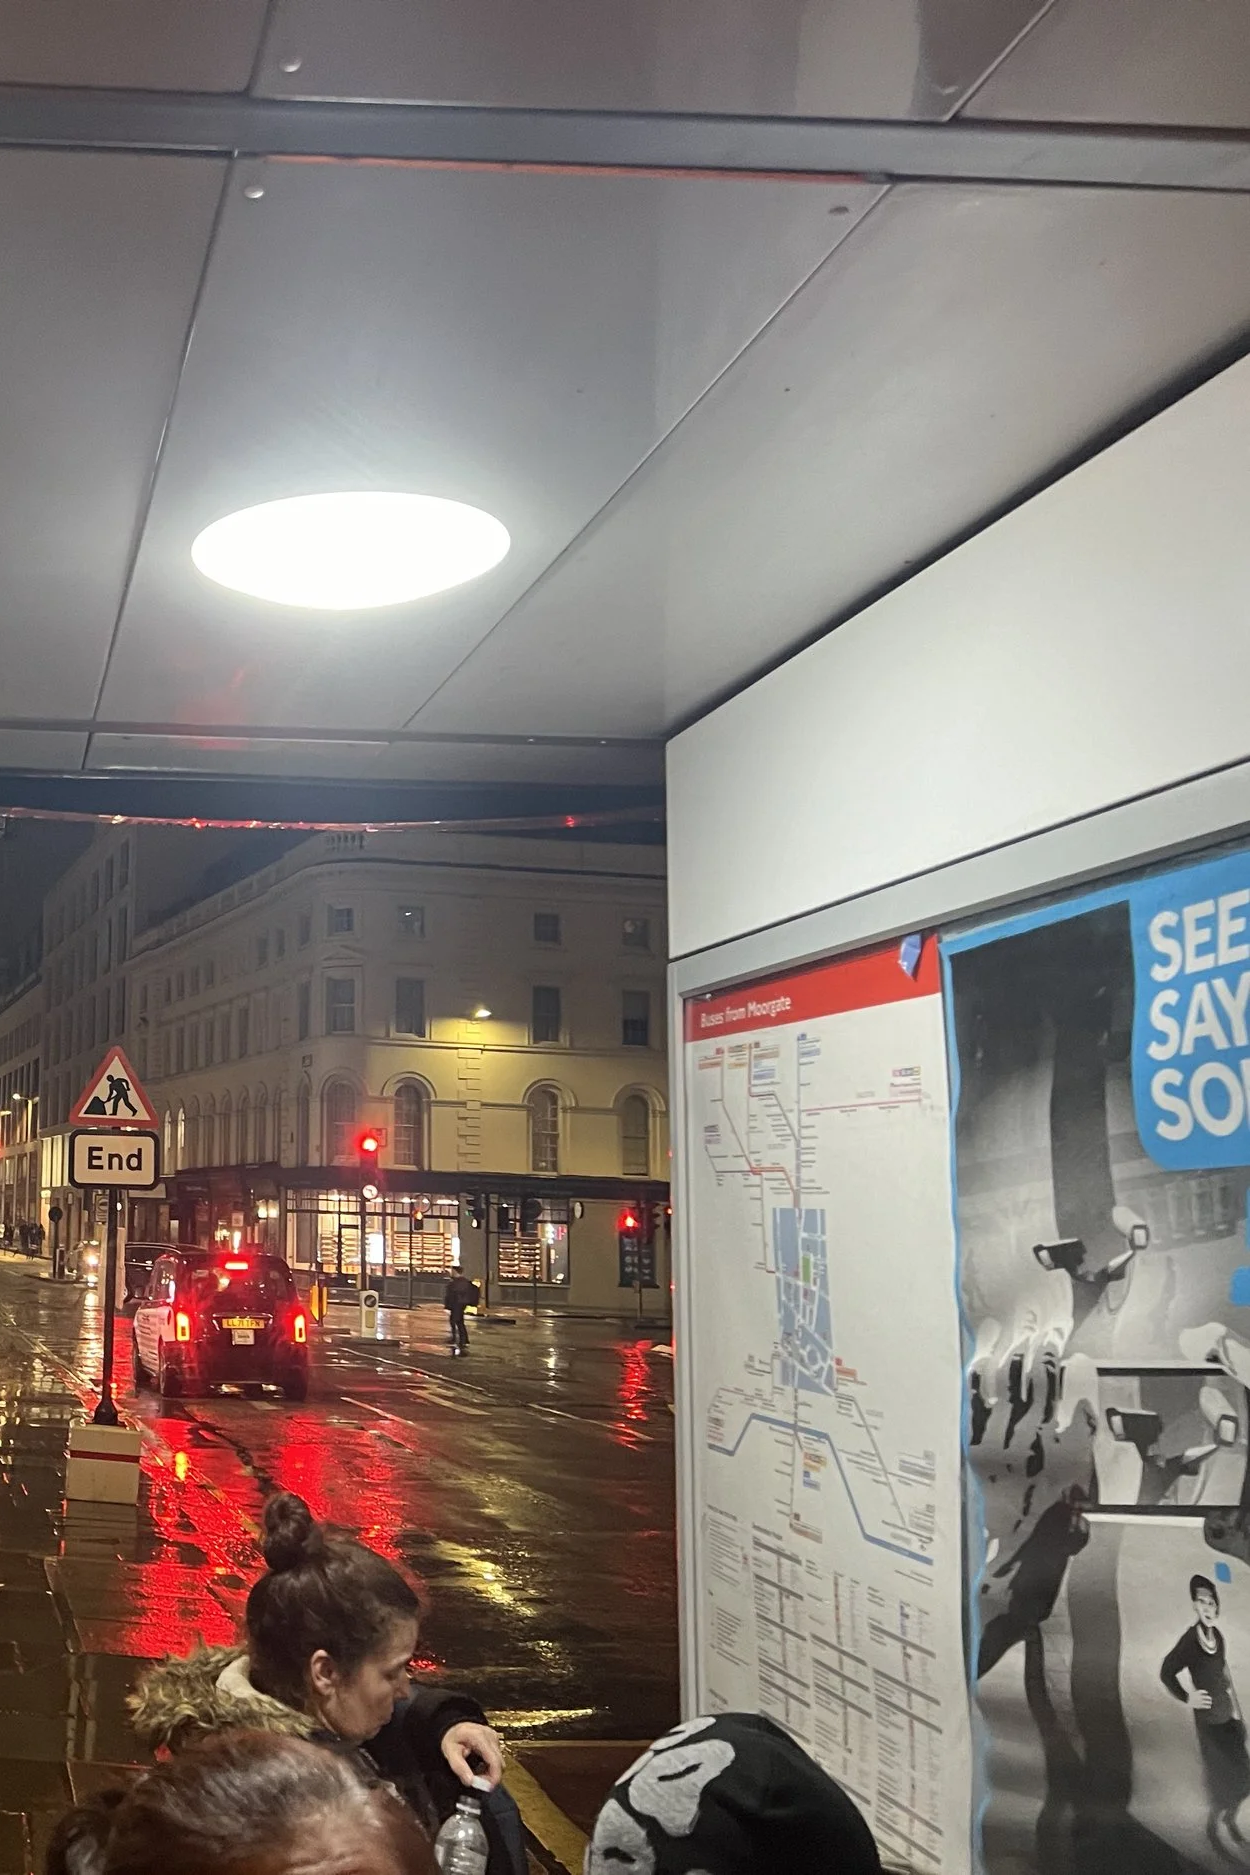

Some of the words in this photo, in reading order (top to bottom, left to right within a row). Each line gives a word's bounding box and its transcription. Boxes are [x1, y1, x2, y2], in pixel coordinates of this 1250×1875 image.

[1148, 888, 1250, 983] SEE
[701, 1012, 724, 1028] Buses
[725, 1006, 745, 1022] from
[747, 996, 791, 1018] Moorgate
[1146, 971, 1250, 1061] SAY
[1151, 1058, 1250, 1142] SO
[88, 1146, 142, 1171] End
